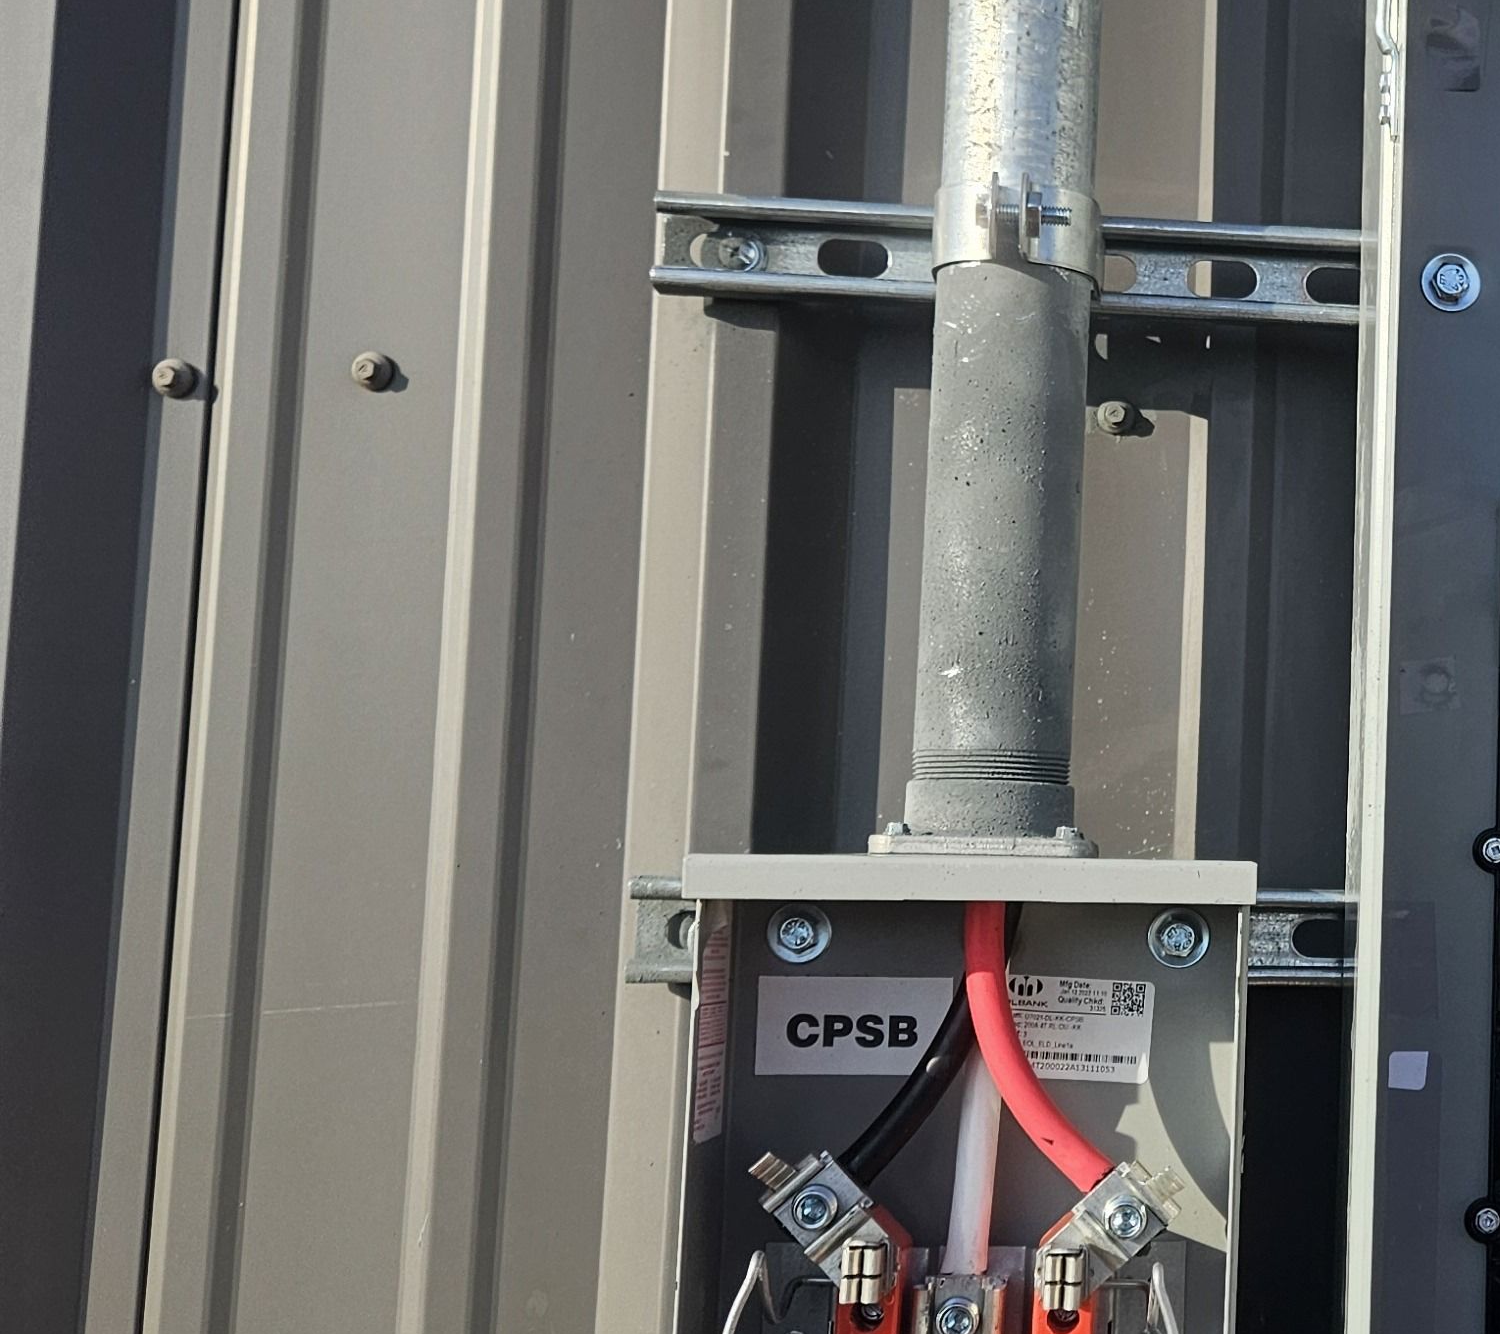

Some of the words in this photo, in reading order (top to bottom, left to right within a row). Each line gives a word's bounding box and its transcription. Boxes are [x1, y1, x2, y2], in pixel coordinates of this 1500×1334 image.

[1059, 981, 1072, 989] Mfg
[1058, 997, 1082, 1005] Quality
[785, 1014, 918, 1048] CPSB
